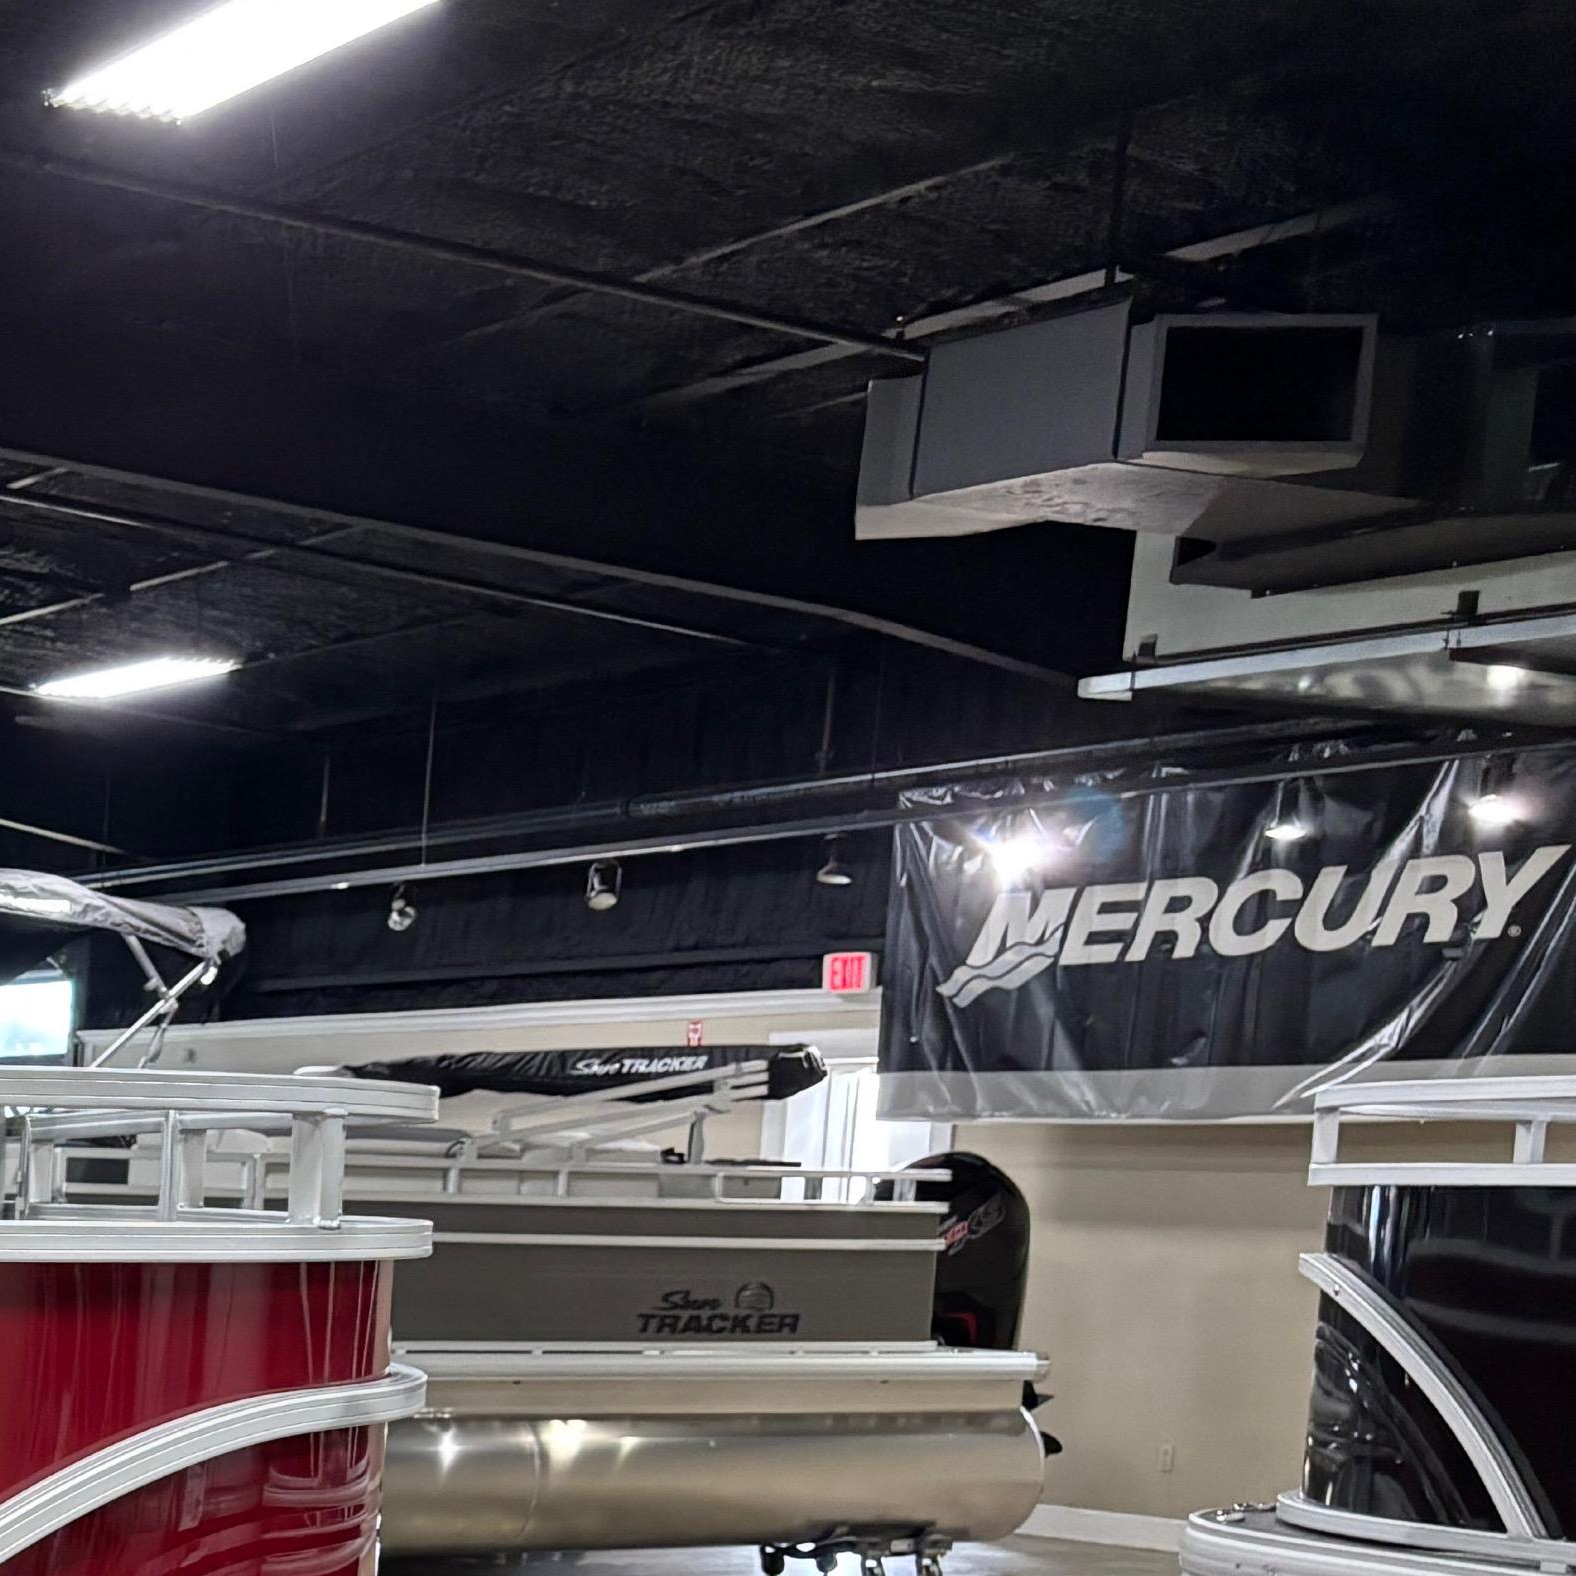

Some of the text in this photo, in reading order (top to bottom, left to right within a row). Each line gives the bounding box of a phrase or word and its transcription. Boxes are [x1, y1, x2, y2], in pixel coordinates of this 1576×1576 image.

[959, 845, 1573, 972] MERCURY
[830, 956, 864, 990] EXIT
[621, 1056, 709, 1074] TRACKER
[636, 1312, 800, 1335] TRACKER
